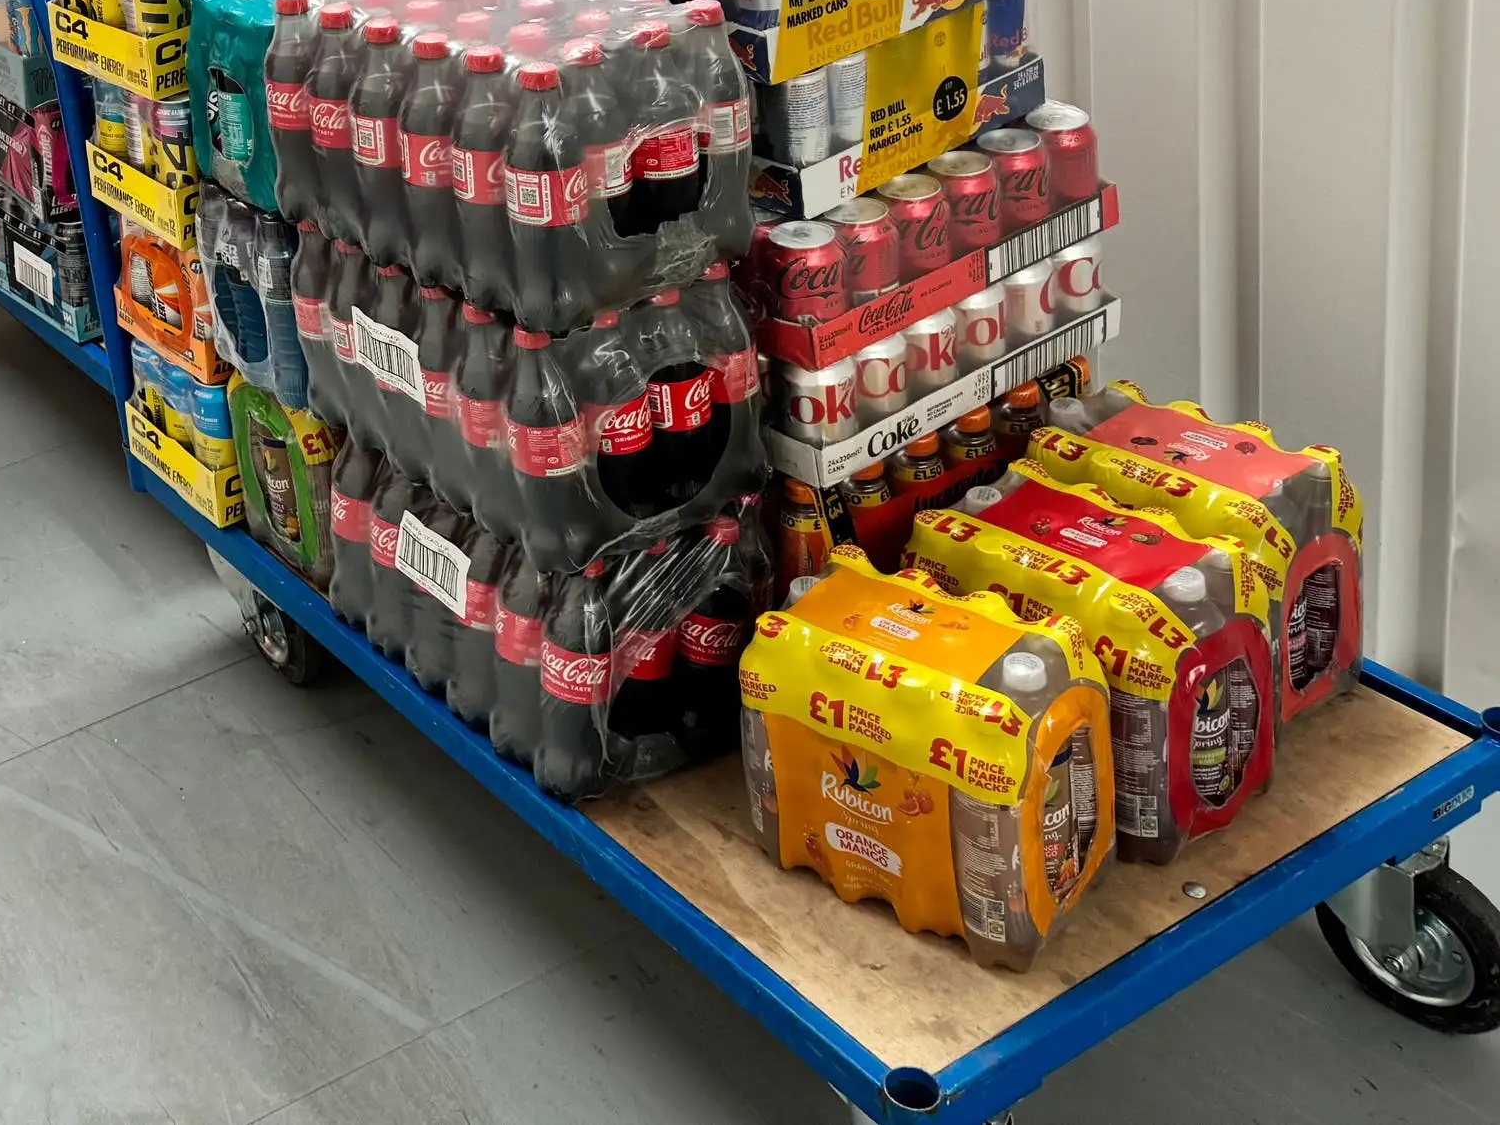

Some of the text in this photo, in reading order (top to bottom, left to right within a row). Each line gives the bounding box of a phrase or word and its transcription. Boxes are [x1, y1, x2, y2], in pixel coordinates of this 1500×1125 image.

[55, 10, 89, 40] C4
[786, 5, 823, 29] MARKED
[56, 37, 100, 65] PERFORMANCE
[100, 55, 125, 78] ENERGY
[808, 20, 901, 67] ENERGY DRINK
[139, 68, 147, 82] 12
[870, 99, 907, 124] RED BULL
[935, 88, 966, 116] £ 1.55
[868, 122, 924, 154] MARKED CANS
[869, 113, 912, 141] RRP £ 1.55
[92, 150, 124, 182] C4
[134, 197, 156, 223] ENERGY
[131, 413, 162, 451] C4
[301, 427, 333, 456] £1
[867, 416, 920, 458] Coke
[131, 437, 172, 481] PERFORMANCE
[964, 444, 994, 459] £1.50
[827, 464, 845, 475] CANS
[913, 464, 942, 481] £1.50
[1152, 472, 1198, 498] £1
[933, 515, 982, 543] £1
[1264, 526, 1294, 560] £1
[918, 556, 947, 573] PRICE
[1043, 558, 1092, 586] £1
[1148, 616, 1188, 649] £1
[1093, 634, 1129, 678] £1
[1130, 655, 1164, 674] PRICE
[865, 661, 908, 689] £1
[1126, 673, 1163, 691] PACKS
[1127, 665, 1172, 685] MARKED
[809, 690, 846, 729] £1
[848, 704, 882, 725] PRICE
[848, 714, 893, 742] MARKED
[848, 725, 885, 746] PACKS
[929, 737, 969, 780] £1
[969, 756, 1005, 776] PRICE
[821, 770, 894, 823] Rubicon
[967, 775, 1010, 794] PACKS
[835, 828, 890, 859] ORANGE
[839, 839, 889, 868] MANGO
